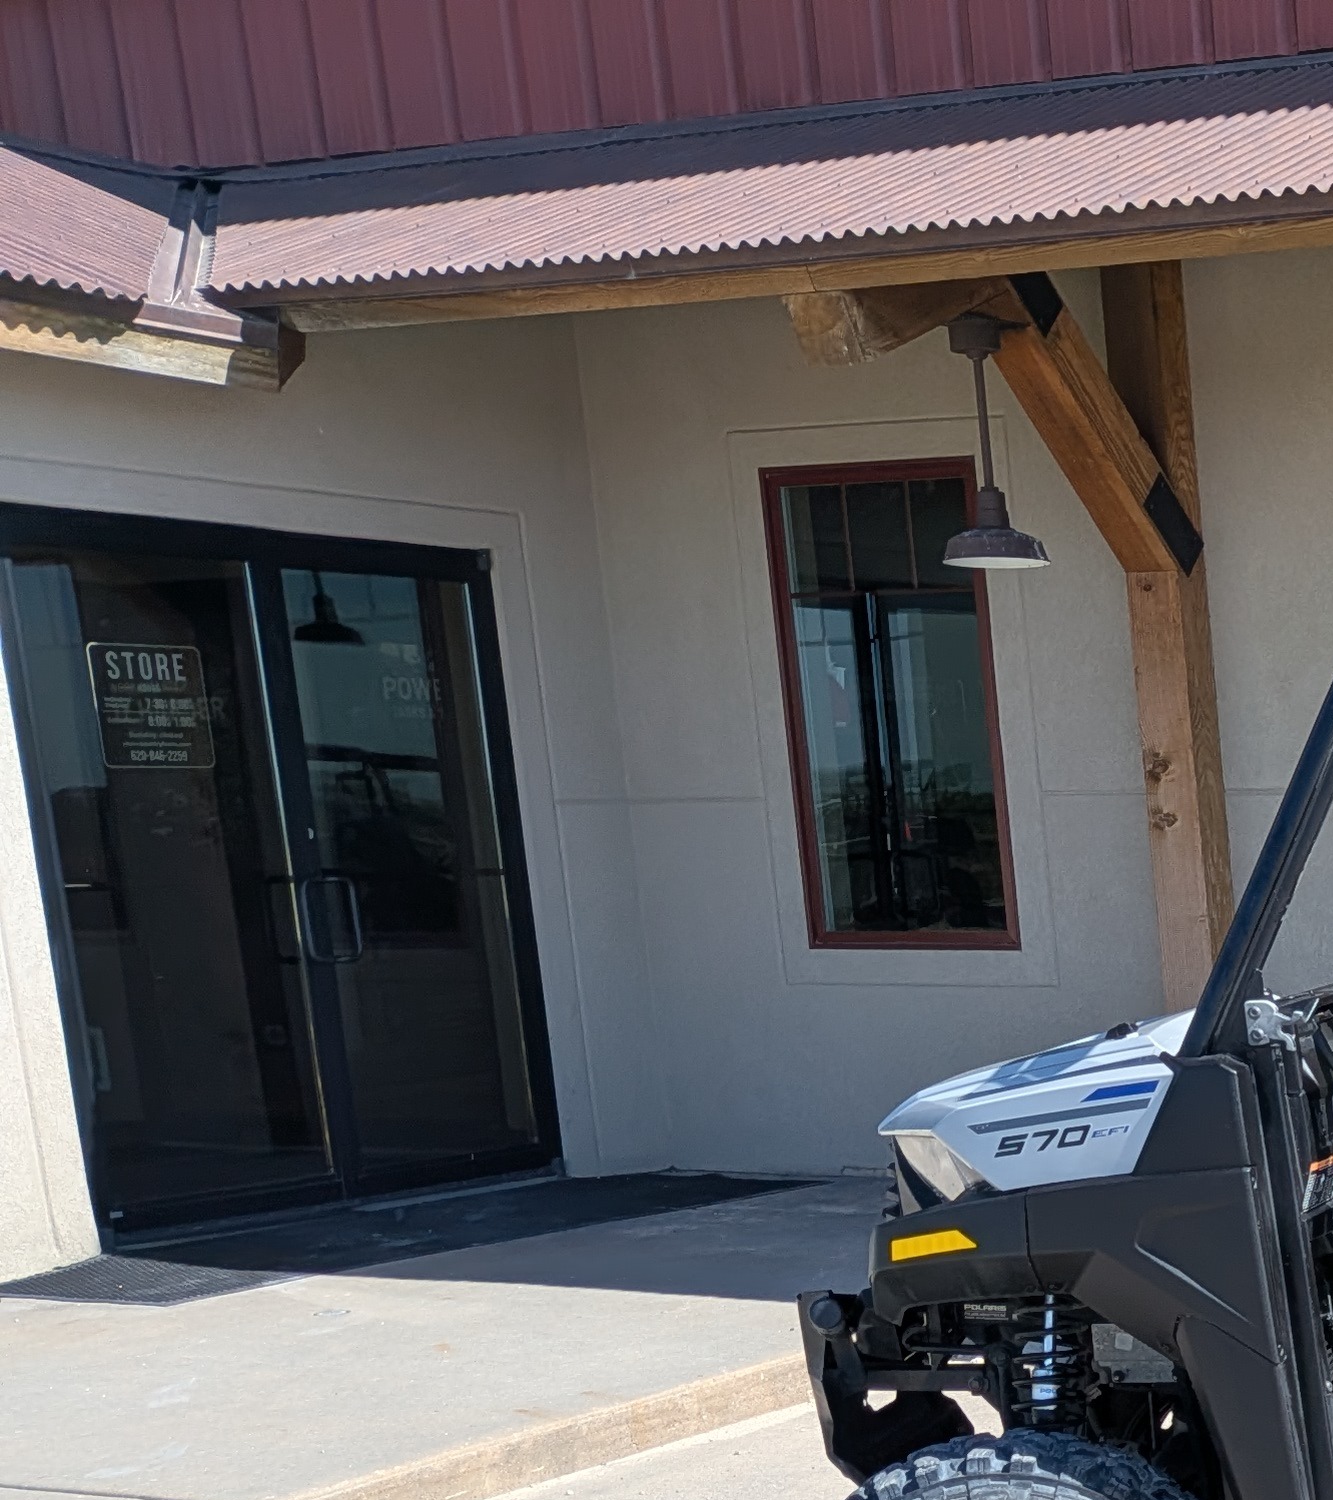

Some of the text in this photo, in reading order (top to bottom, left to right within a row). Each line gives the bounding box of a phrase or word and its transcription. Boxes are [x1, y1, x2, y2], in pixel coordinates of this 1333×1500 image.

[105, 650, 187, 681] STORE
[994, 1123, 1129, 1159] 570 EFI
